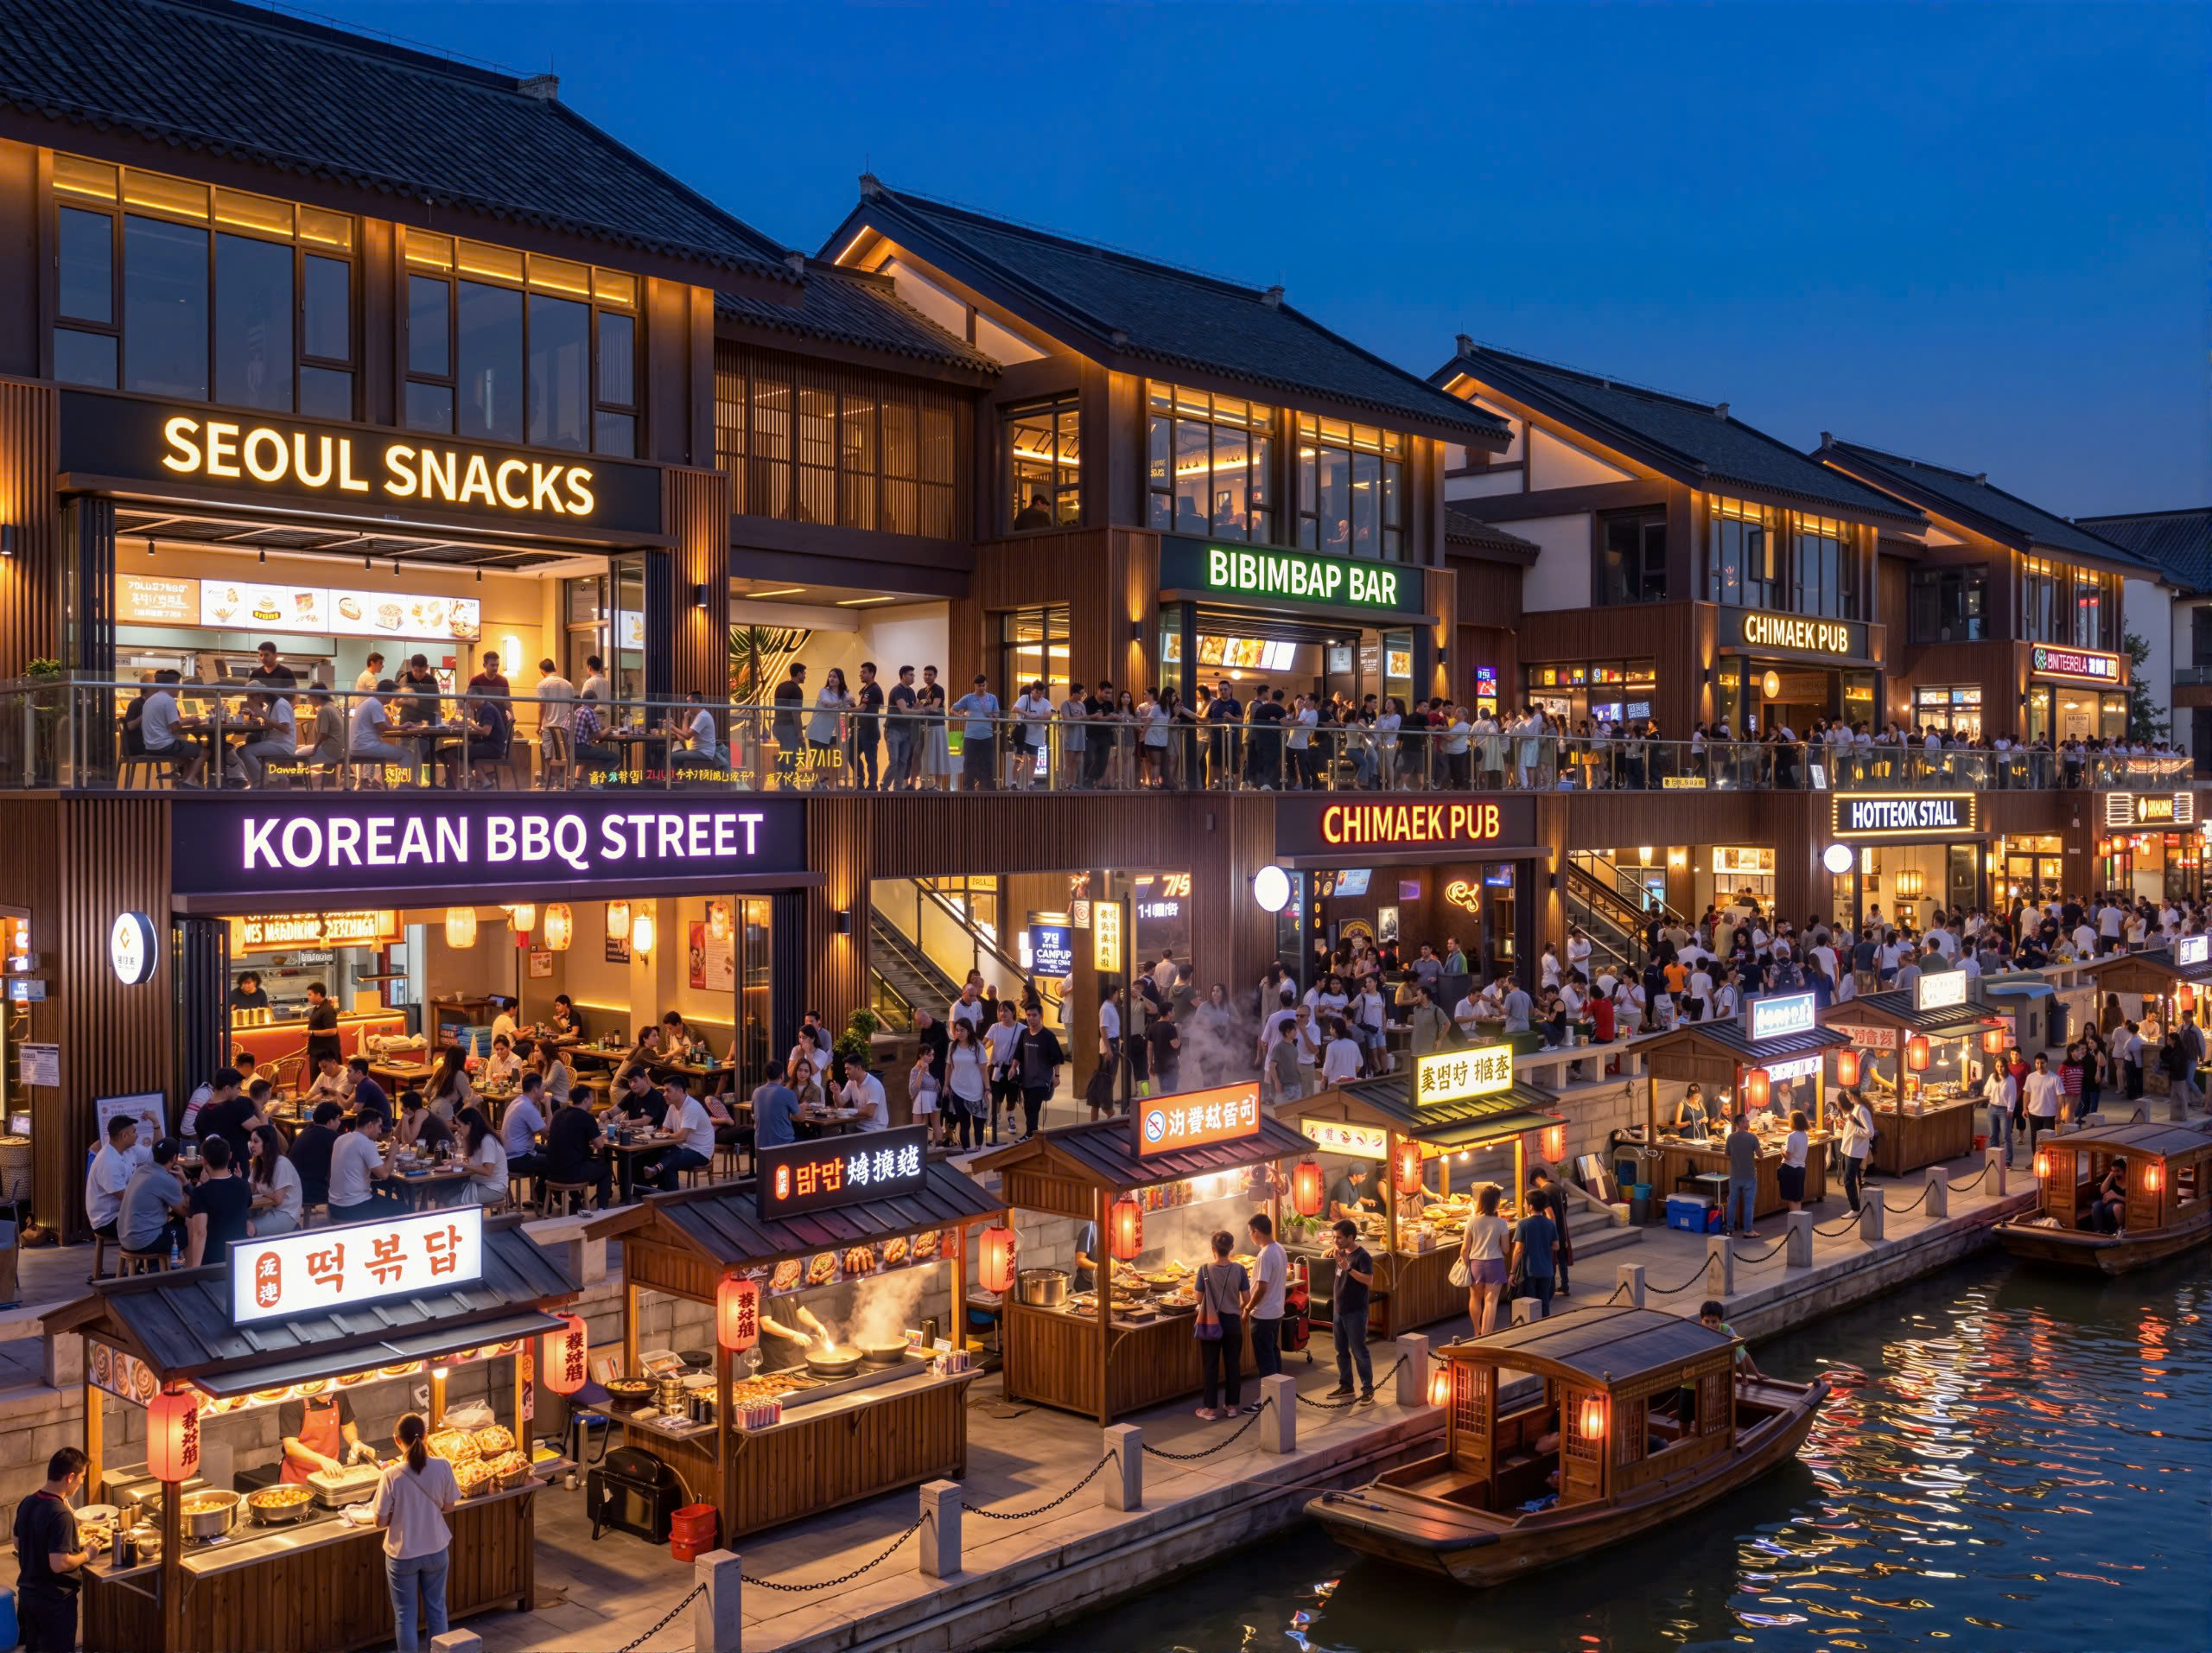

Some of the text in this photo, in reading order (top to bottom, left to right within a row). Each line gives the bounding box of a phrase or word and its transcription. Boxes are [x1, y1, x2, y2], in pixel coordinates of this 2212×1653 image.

[162, 416, 596, 516] SEOUL SNACKS
[1210, 550, 1397, 605] BIBIMBAP BAR
[1745, 614, 1848, 652] CHIMAEK PUB
[1323, 804, 1501, 843] CHIMAEK PUB
[1853, 800, 1958, 829] HOTTEOK STALL
[243, 812, 765, 871] KOREAN BBQ STREET
